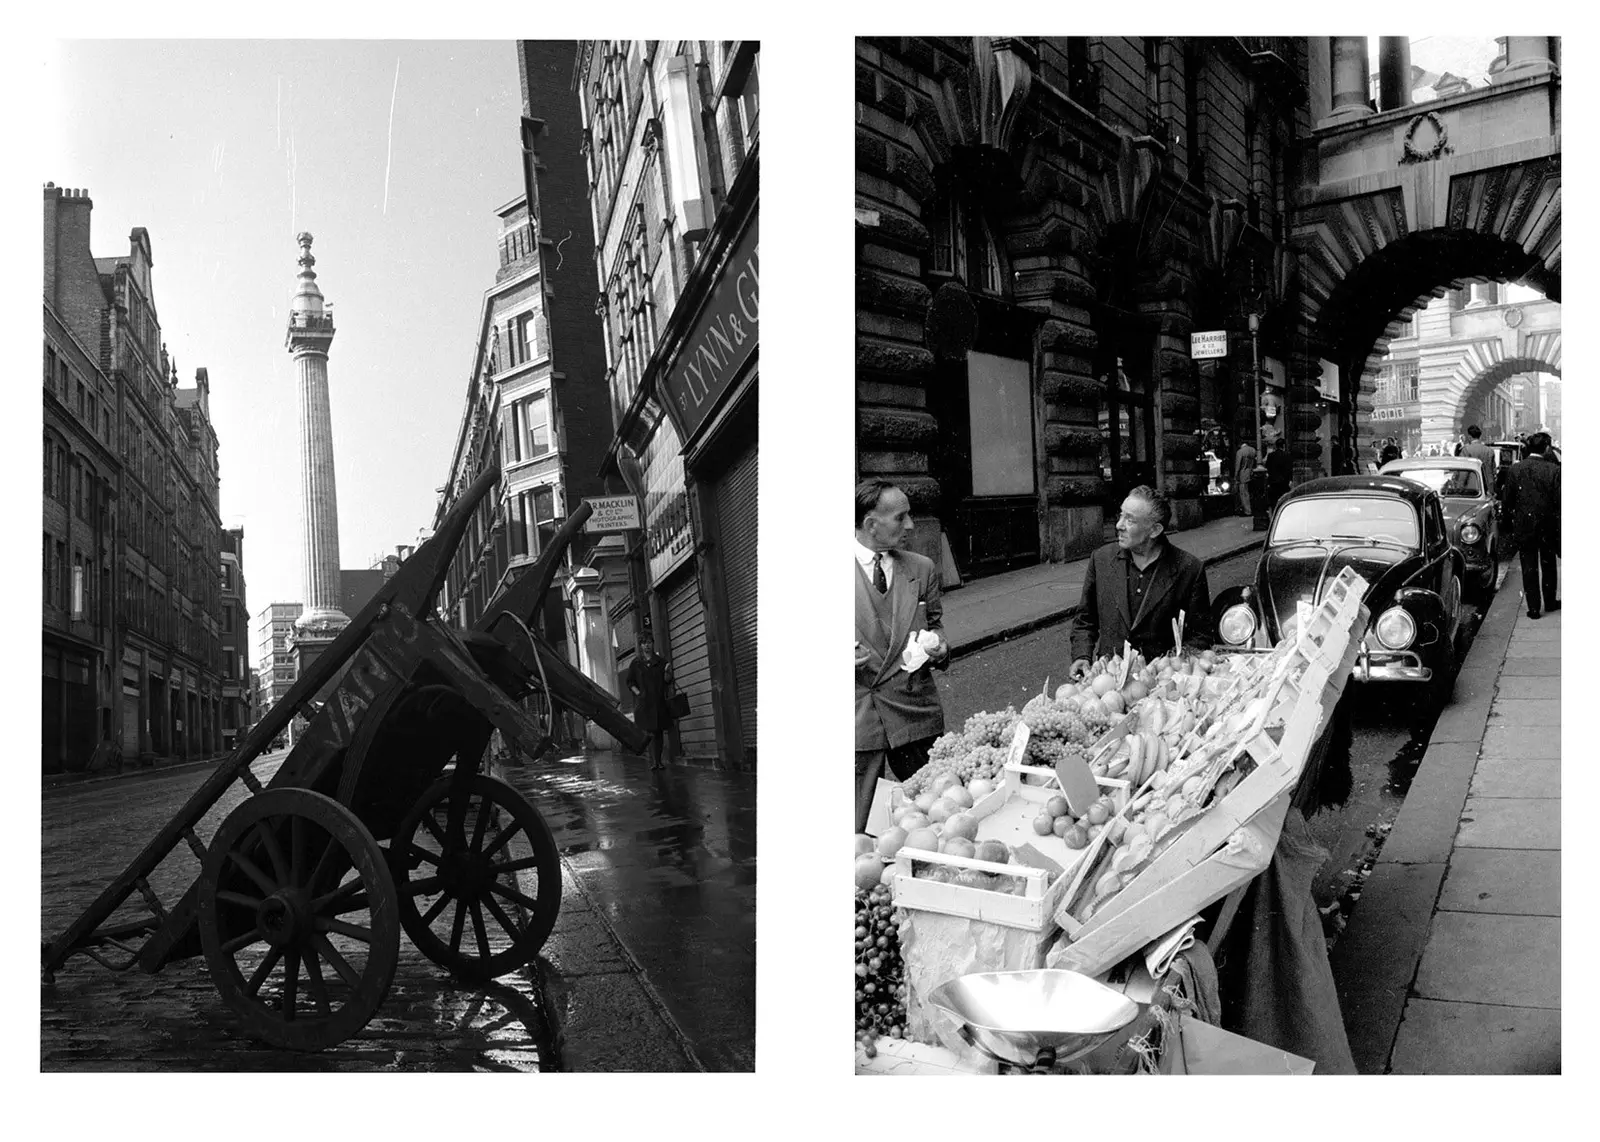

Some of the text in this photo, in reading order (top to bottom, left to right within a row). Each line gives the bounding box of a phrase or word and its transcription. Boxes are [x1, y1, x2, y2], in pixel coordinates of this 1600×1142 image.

[683, 313, 735, 408] LYNN
[729, 312, 748, 346] &
[1194, 348, 1224, 356] JEWELLERS
